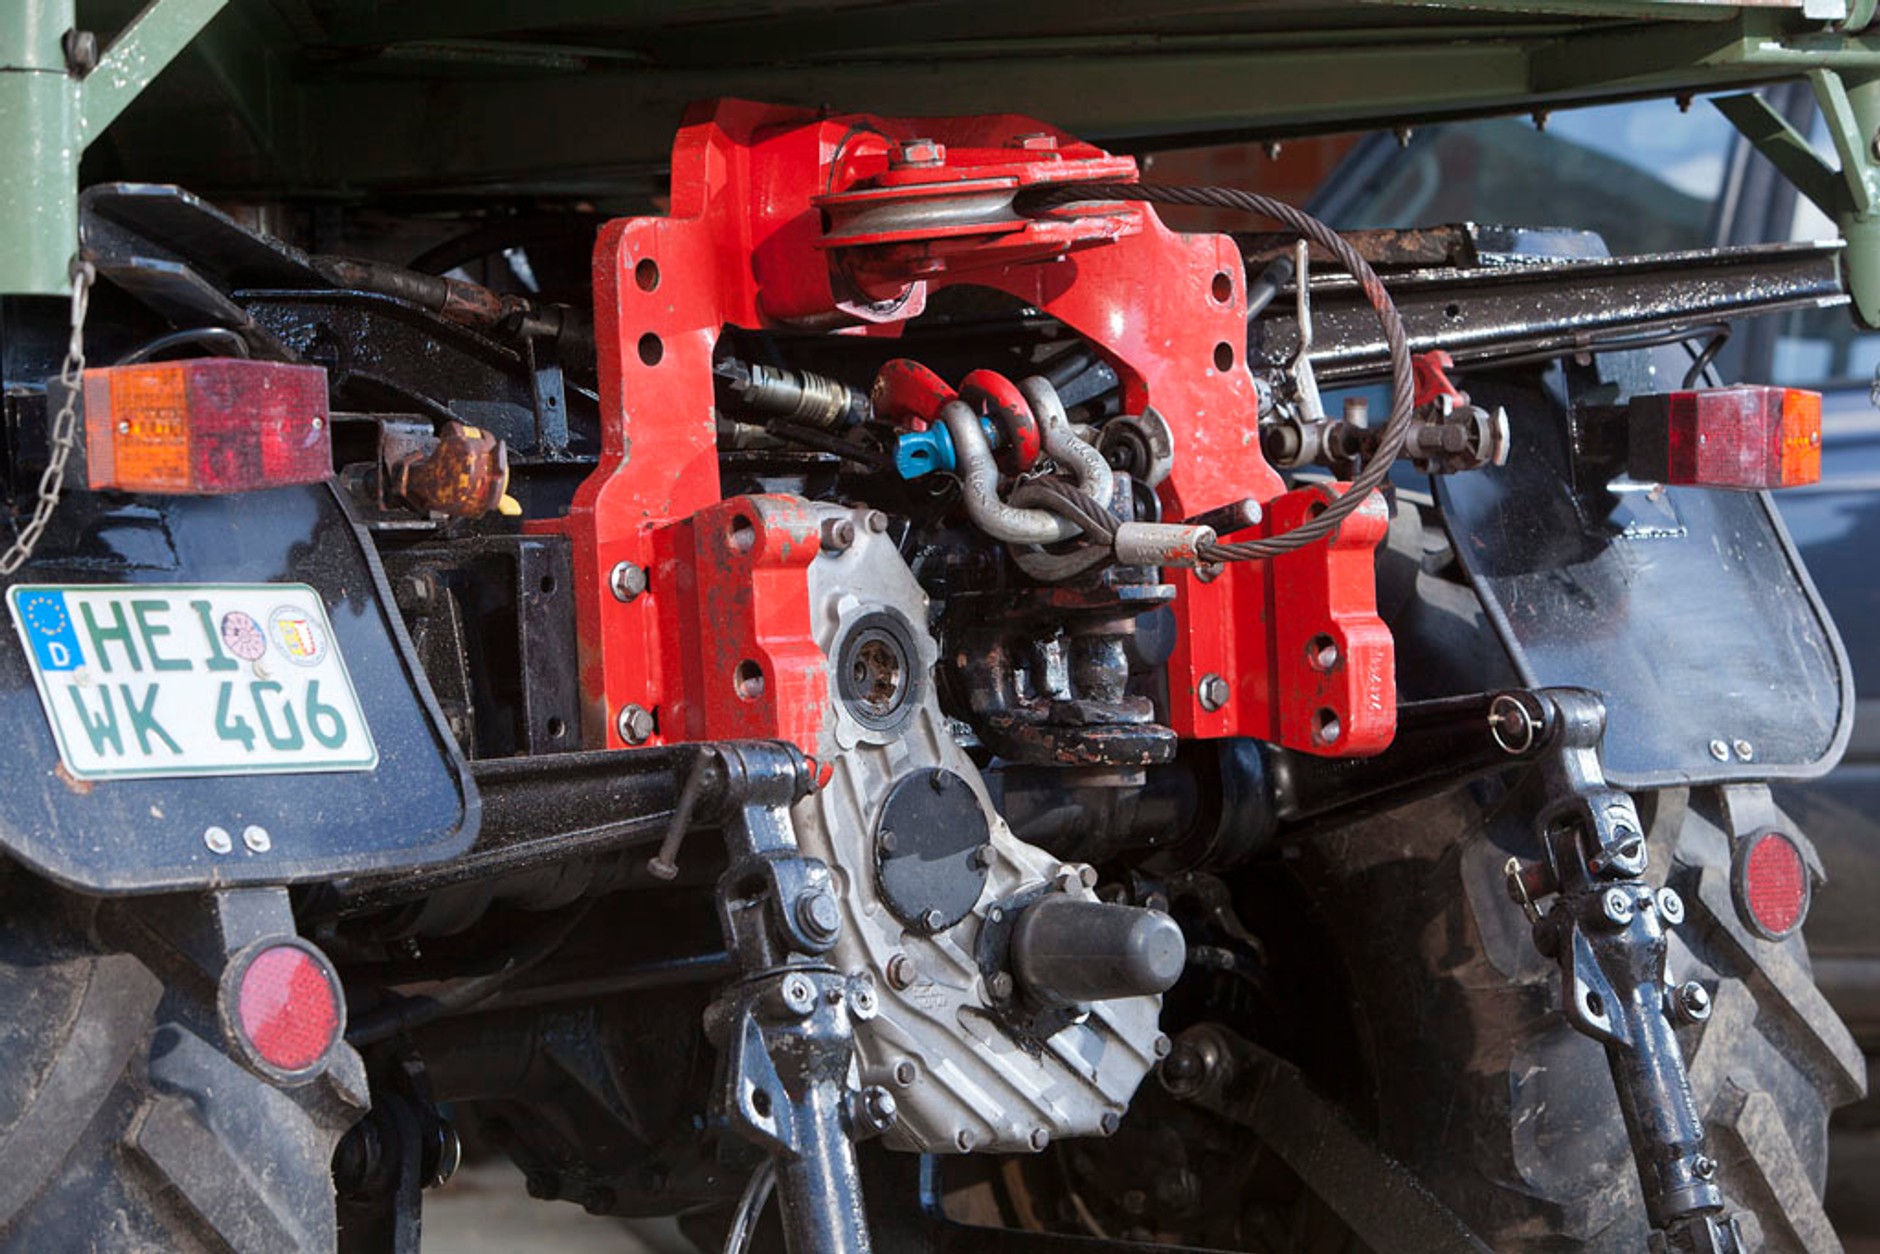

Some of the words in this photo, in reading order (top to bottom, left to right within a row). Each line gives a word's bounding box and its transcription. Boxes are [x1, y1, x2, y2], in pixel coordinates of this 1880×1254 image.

[48, 642, 70, 667] D
[80, 600, 239, 672] HEI
[68, 683, 184, 756] WK
[215, 679, 347, 751] 406
